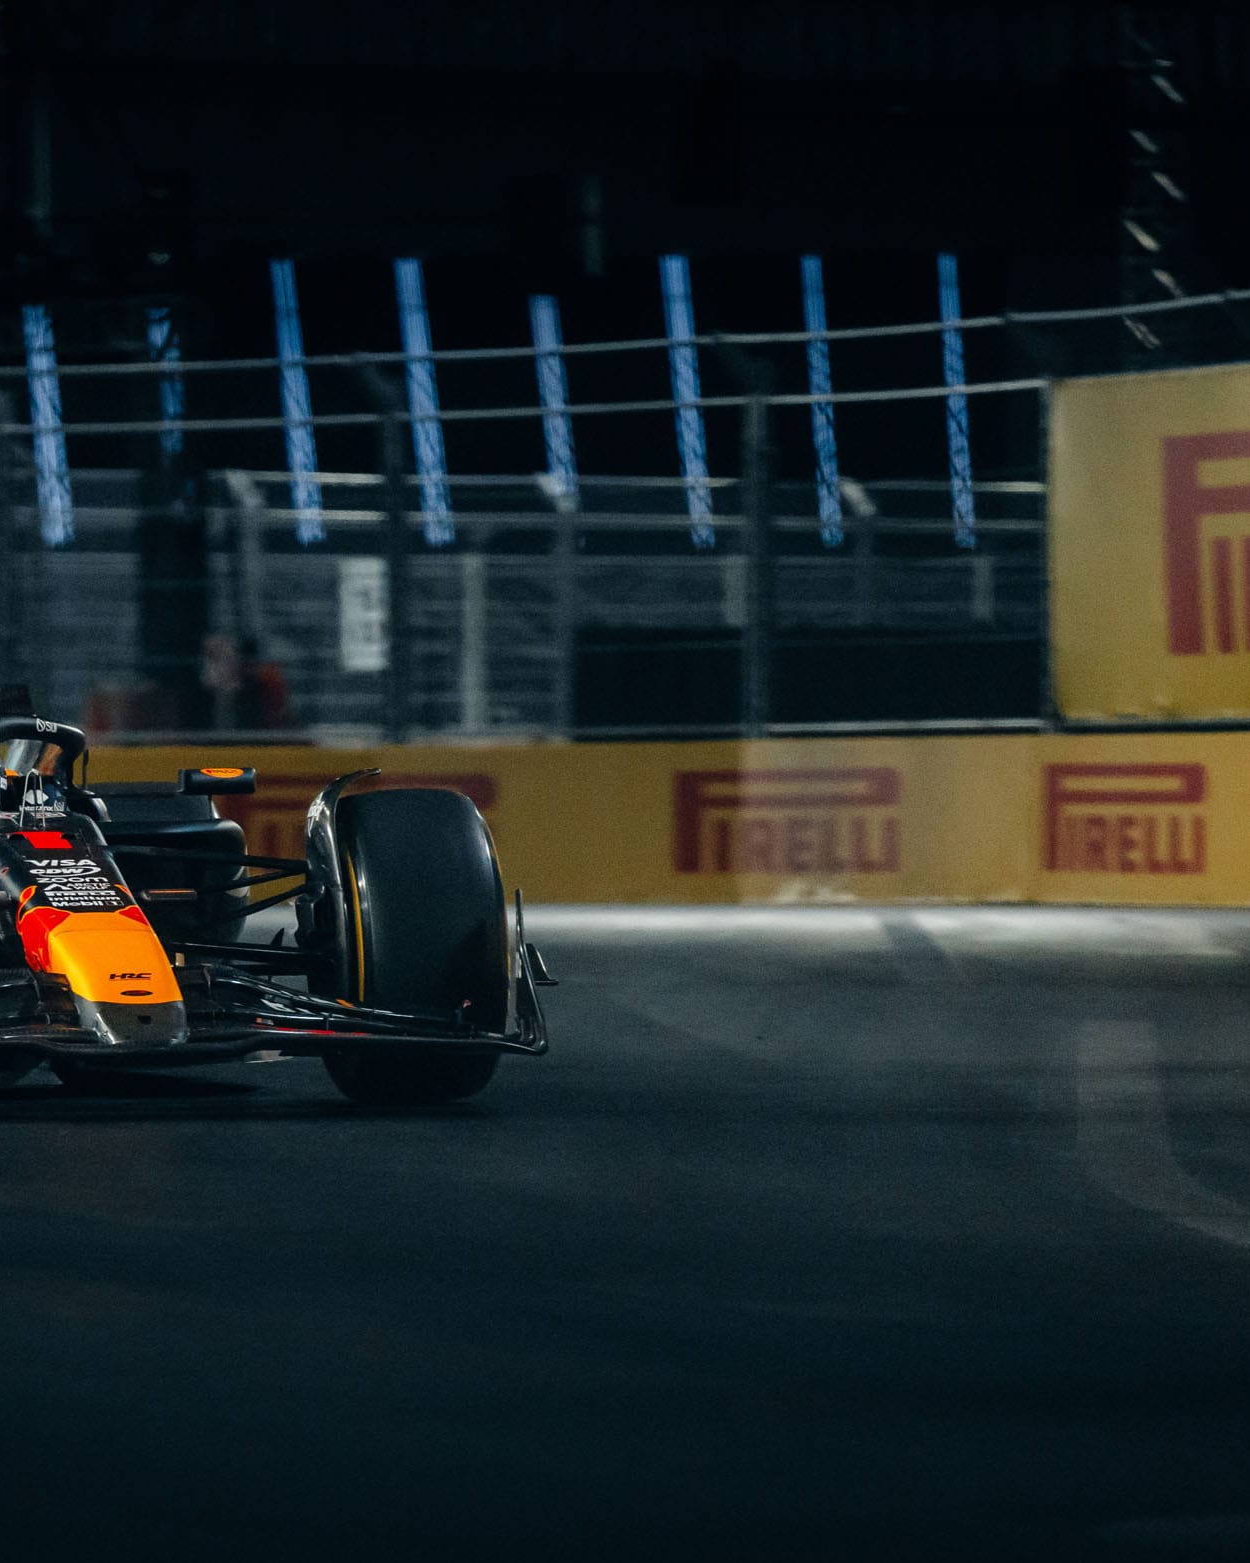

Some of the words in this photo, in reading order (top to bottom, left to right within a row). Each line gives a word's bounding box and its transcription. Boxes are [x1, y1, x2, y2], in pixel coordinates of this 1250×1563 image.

[672, 768, 900, 874] PIRELLI
[1043, 763, 1206, 874] PIRELLI
[29, 868, 87, 876] CDW
[109, 972, 152, 980] HRC
